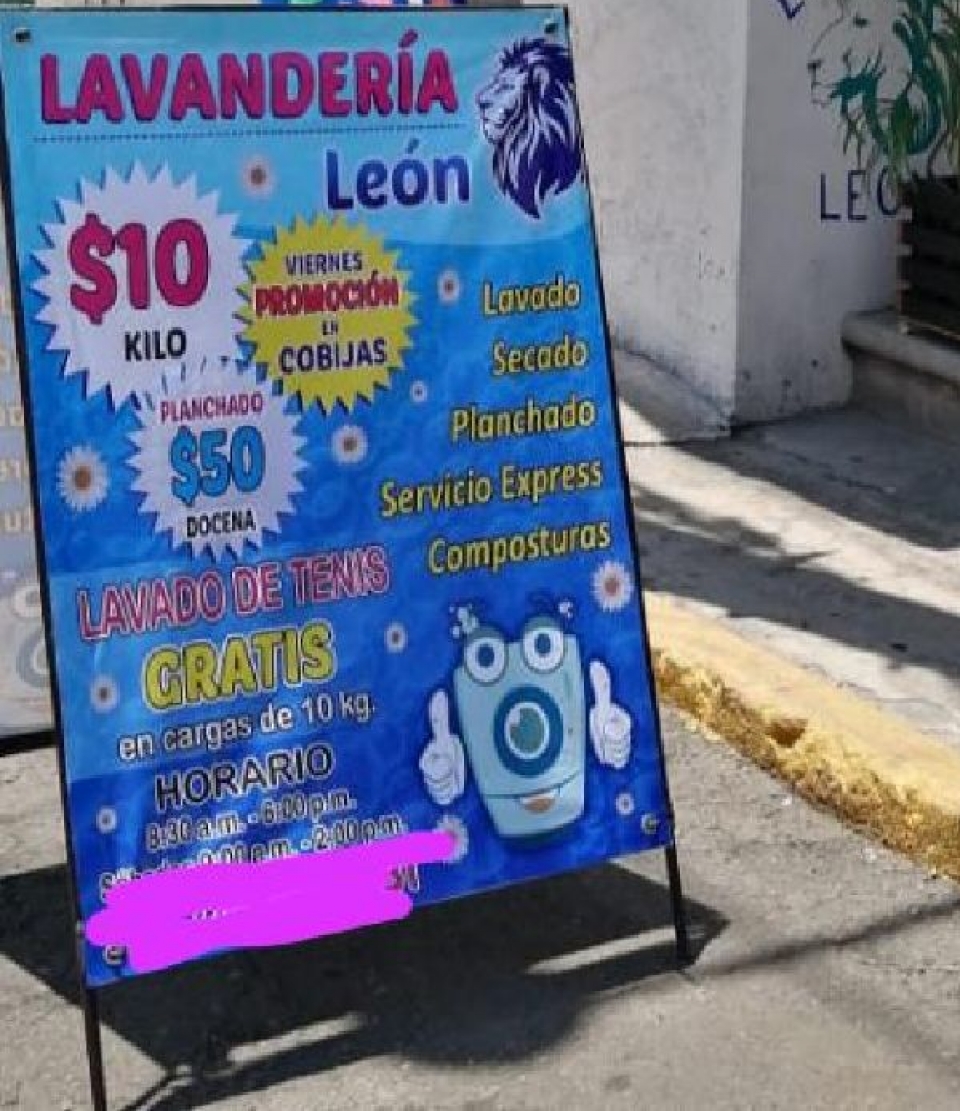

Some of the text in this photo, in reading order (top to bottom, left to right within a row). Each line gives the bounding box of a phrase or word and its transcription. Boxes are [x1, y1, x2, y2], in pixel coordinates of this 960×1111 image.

[40, 28, 460, 125] LAVANDERÍA
[324, 140, 472, 211] León
[819, 164, 900, 223] LEO
[69, 213, 211, 325] $10
[285, 250, 364, 276] VIERNES
[254, 269, 402, 318] PROMOCIÓN
[482, 271, 582, 318] Lavado
[124, 327, 188, 363] KILO
[279, 337, 388, 374] COBIJAS
[491, 333, 590, 378] Secado
[160, 391, 264, 424] PLANCHADO
[450, 393, 597, 443] Planchado
[169, 425, 266, 508] $50
[379, 459, 605, 520] Servicio Express
[186, 509, 257, 539] DOCENA
[427, 517, 612, 576] Composturas
[76, 541, 391, 641] LAVADO DE TENIS
[141, 617, 338, 713] GRATIS
[117, 731, 155, 763] en
[163, 713, 254, 752] cargas
[259, 701, 295, 734] de
[301, 693, 334, 725] 10
[154, 742, 335, 812] HORARIO
[260, 791, 307, 825] 6:00
